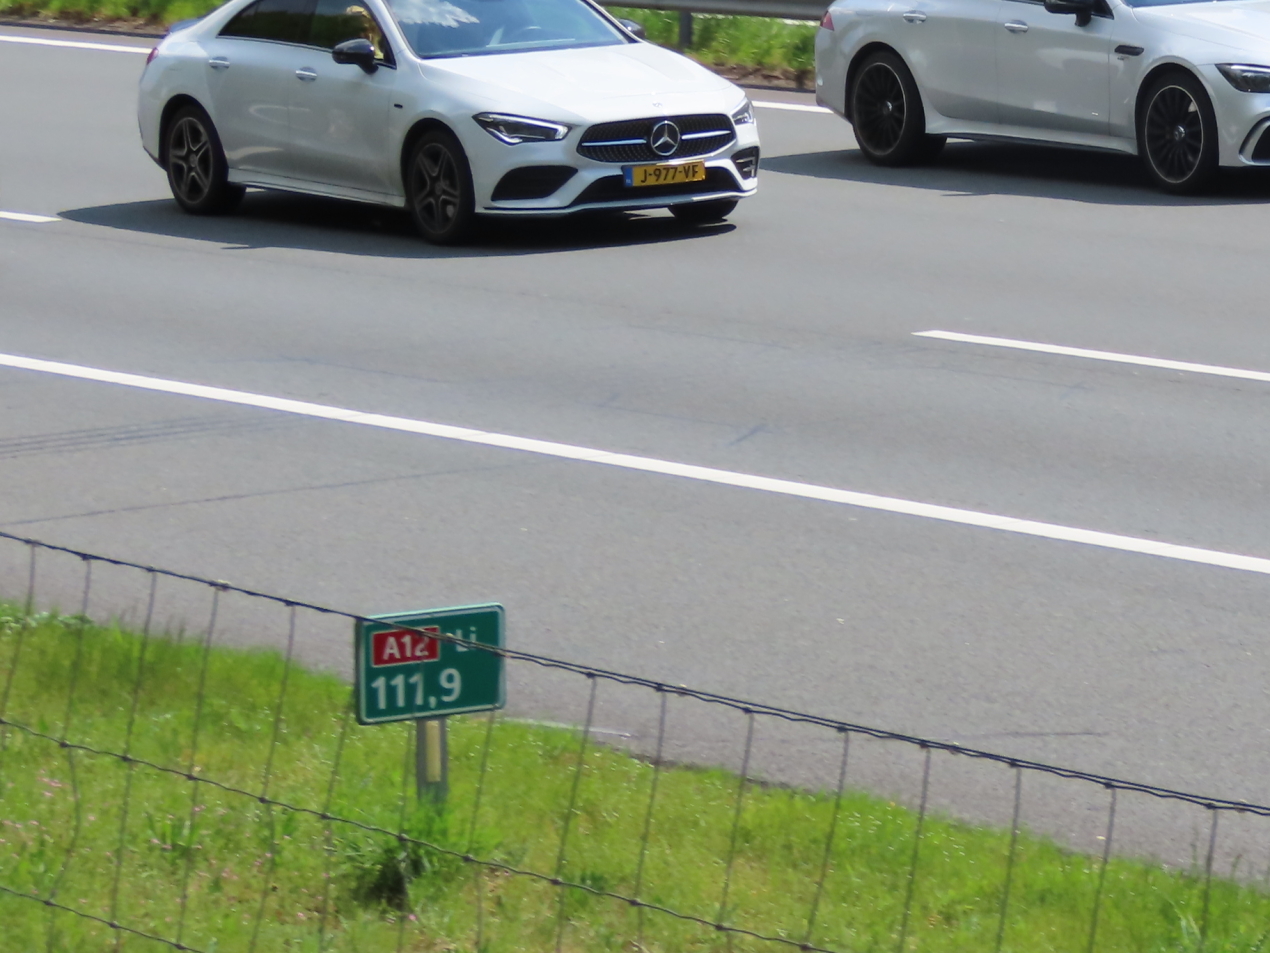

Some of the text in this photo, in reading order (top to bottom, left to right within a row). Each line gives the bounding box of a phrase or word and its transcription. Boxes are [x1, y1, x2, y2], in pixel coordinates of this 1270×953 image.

[640, 164, 699, 183] J-977-VF
[382, 626, 477, 660] A12 Li
[371, 668, 462, 709] 111,9
